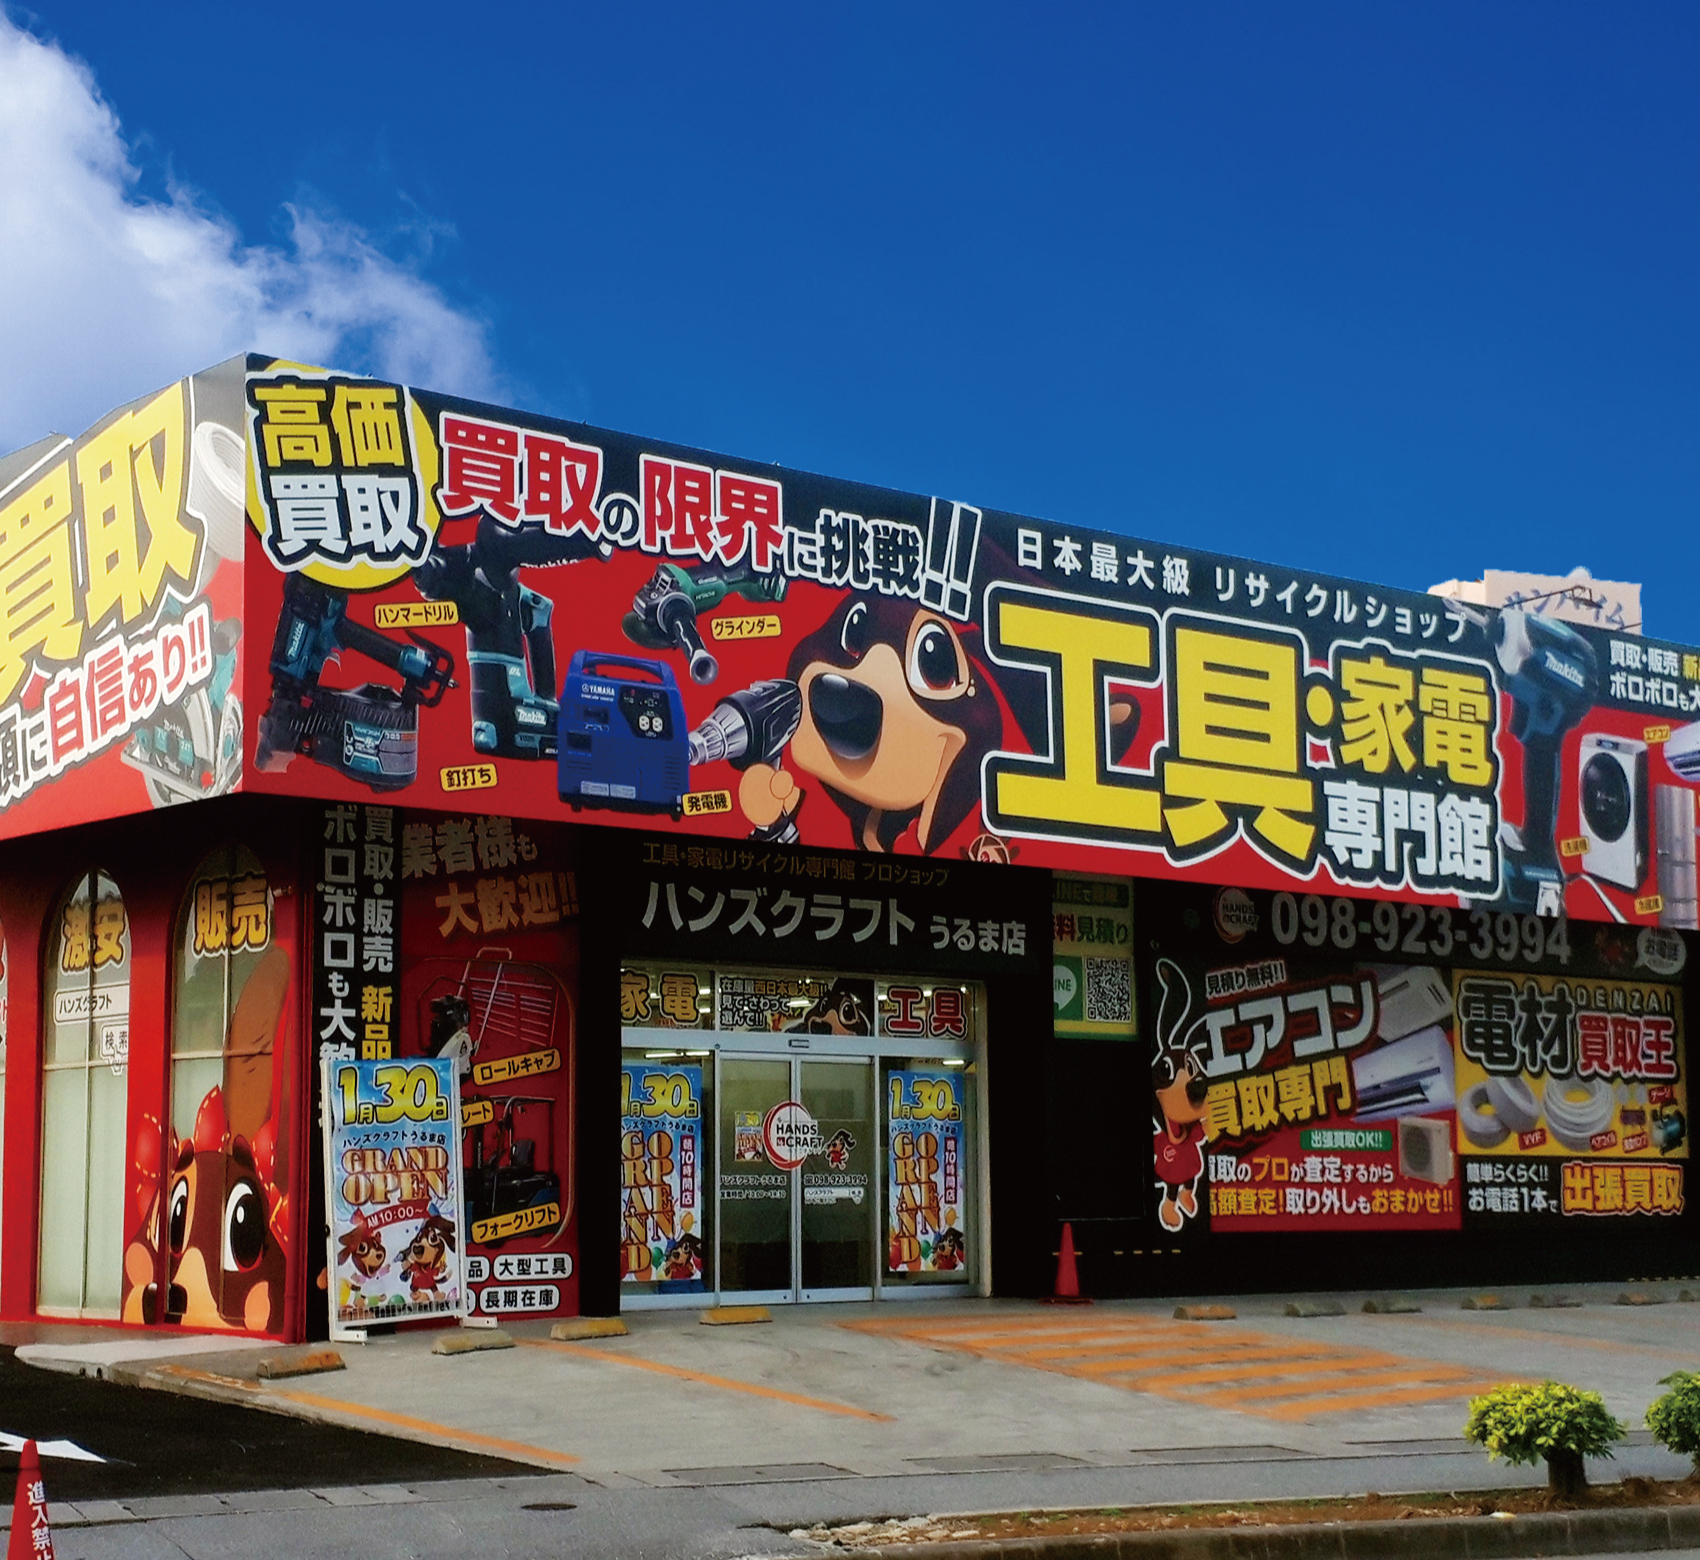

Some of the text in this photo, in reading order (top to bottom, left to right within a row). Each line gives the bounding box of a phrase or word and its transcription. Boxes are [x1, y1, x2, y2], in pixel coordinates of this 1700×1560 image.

[254, 384, 406, 468] 高価
[270, 474, 418, 556] 買取
[0, 381, 197, 700] 買取
[1017, 528, 1467, 643] 日本最大級 リサイクルショップ
[378, 608, 455, 624] ハンマードリル
[713, 620, 777, 636] グラインダー
[1610, 640, 1700, 680] 買取・販売 新
[590, 685, 615, 696] YAMAHA
[996, 602, 1493, 861] 工具・家電
[445, 768, 492, 787] 釘打ち
[688, 795, 728, 812] 発電機
[402, 816, 538, 879] 業者様も
[1323, 779, 1492, 882] 専門館
[643, 841, 950, 887] 工具・家電リサイクル専門館 プロショップ
[195, 875, 268, 951] 販売
[435, 871, 579, 937] 大歓迎!!
[642, 882, 1027, 956] ハンズクラフト うるま店
[1271, 891, 1571, 965] 098-923-3994
[361, 806, 394, 1060] 買取・販売 新品
[1053, 914, 1128, 944] 料見積り
[621, 970, 708, 1021] 家電
[1053, 979, 1072, 991] INE
[1208, 961, 1285, 996] 見積り無料!!
[59, 994, 112, 1014] ハンズクラフト
[888, 989, 964, 1035] 工具
[1460, 980, 1673, 1073] 電材 DENZAI
[105, 1030, 128, 1050] 検索
[1206, 980, 1374, 1077] エアコン
[1578, 1015, 1677, 1077] 買取王
[340, 1065, 448, 1124] 1月30日
[621, 1073, 698, 1118] 1月30日
[890, 1077, 961, 1121] 1月30日
[1207, 1056, 1352, 1141] 買取専門
[776, 1123, 817, 1135] HANDS
[786, 1137, 823, 1147] CRAFT
[341, 1146, 450, 1174] GRAND
[916, 1131, 941, 1235] OPEN
[342, 1170, 448, 1206] OPEN
[621, 1131, 652, 1274] GRAND
[647, 1131, 676, 1242] OPEN
[893, 1132, 921, 1264] GRAND
[1563, 1162, 1683, 1213] 出張買取
[367, 1217, 379, 1229] AM
[477, 1207, 557, 1239] フォークリフト
[499, 1258, 567, 1276] 大型工具
[485, 1289, 554, 1309] 長期在庫
